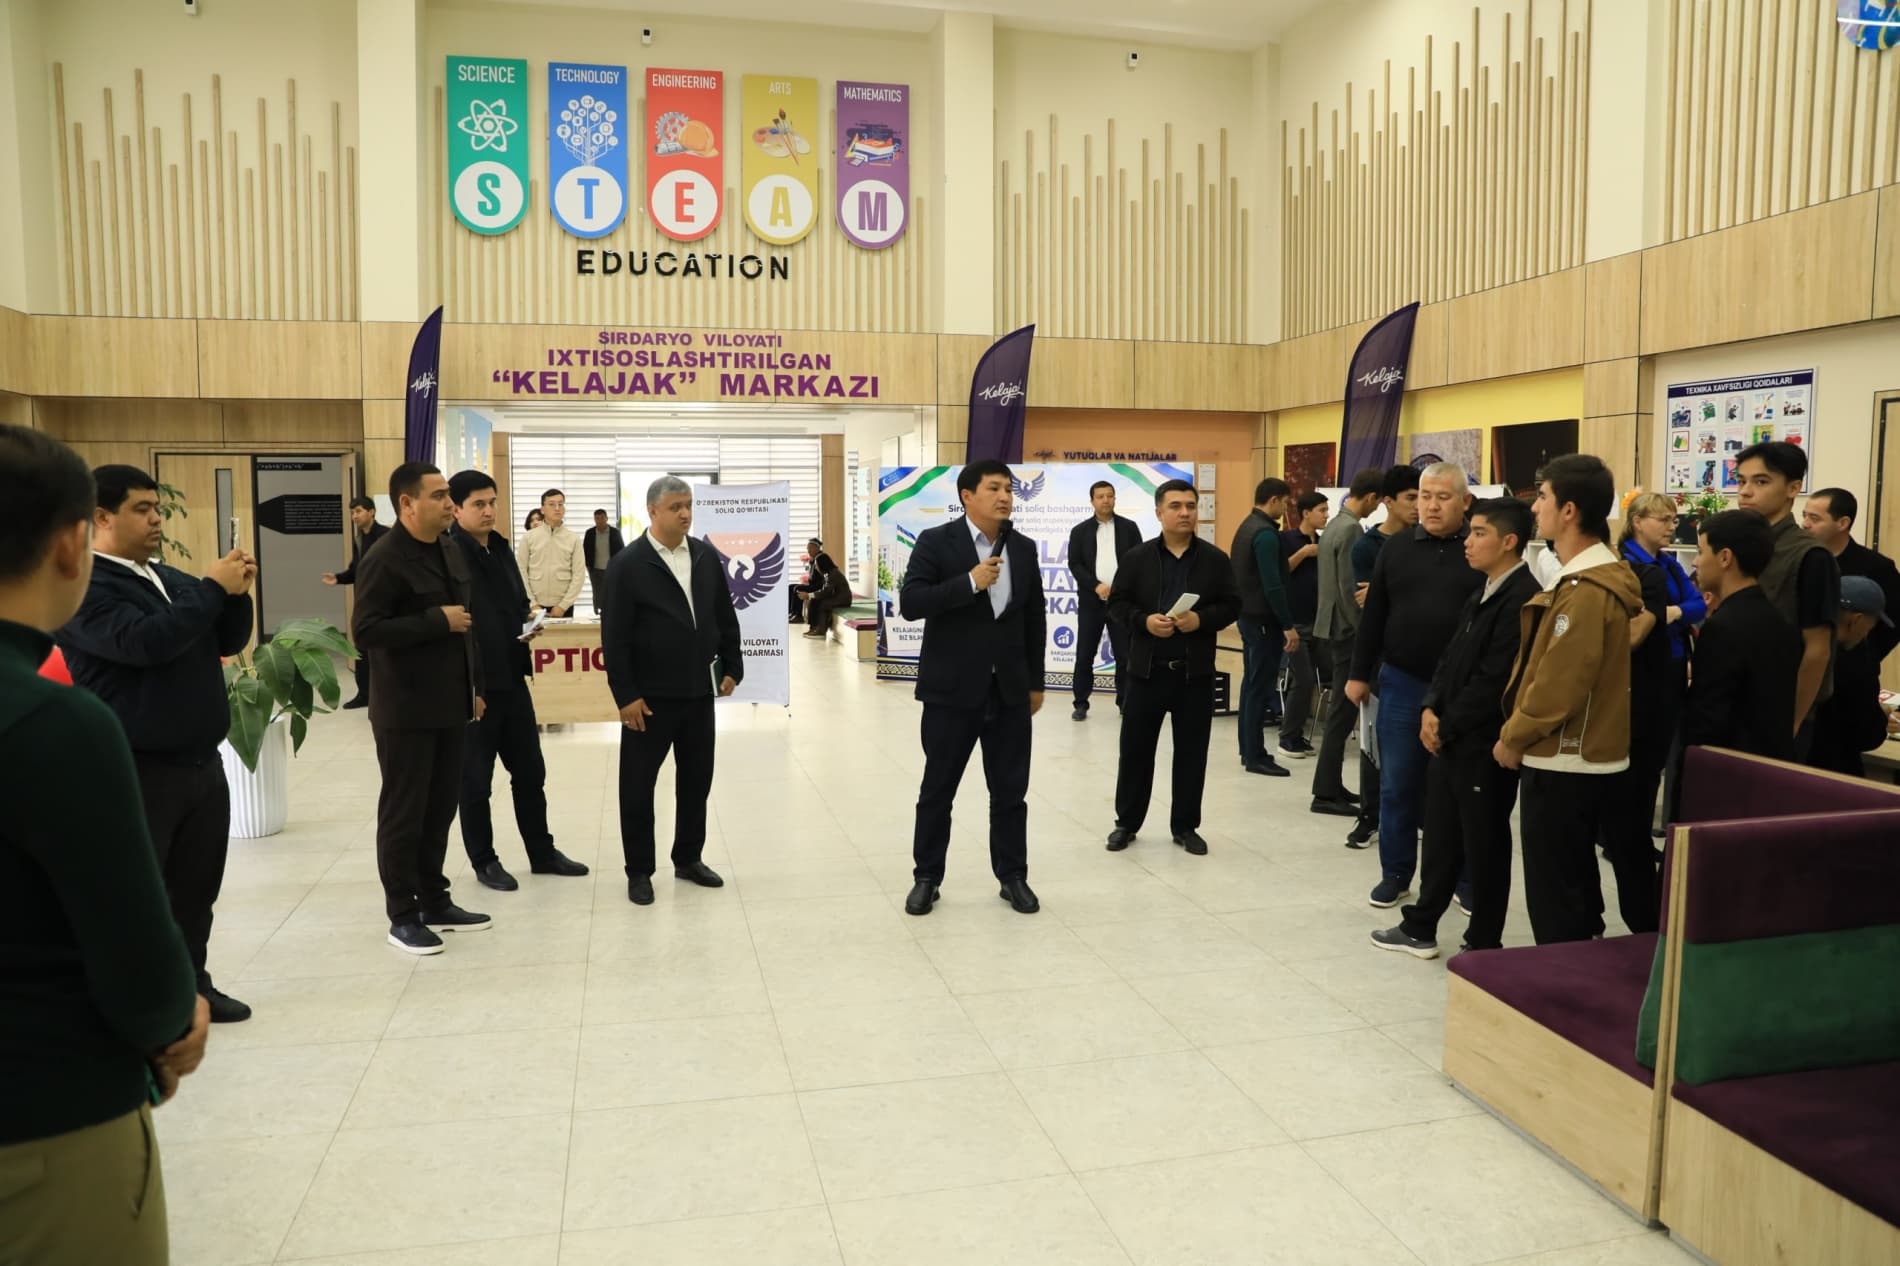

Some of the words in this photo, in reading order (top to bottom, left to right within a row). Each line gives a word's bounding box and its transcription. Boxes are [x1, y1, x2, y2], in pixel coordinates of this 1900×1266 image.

[458, 64, 515, 84] SCIENCE
[555, 68, 619, 85] TECHNOLOGY
[652, 74, 716, 90] ENGINEERING
[768, 81, 791, 96] ARTS
[843, 87, 902, 103] MATHEMATICS
[576, 249, 789, 280] EDUCATION
[598, 331, 693, 347] SIRDARYO
[703, 333, 782, 348] VILOYATI
[548, 349, 831, 371] IXTISOSLASHTIRILGAN
[720, 373, 879, 399] MARKAZI
[1685, 387, 1712, 395] TEXNIKA
[1064, 451, 1113, 461] YUTUQLAR
[1114, 452, 1126, 461] VA
[1128, 452, 1178, 462] NATIJALAR
[741, 497, 788, 505] RESPUBLIKASI
[743, 639, 779, 647] VILOYATI
